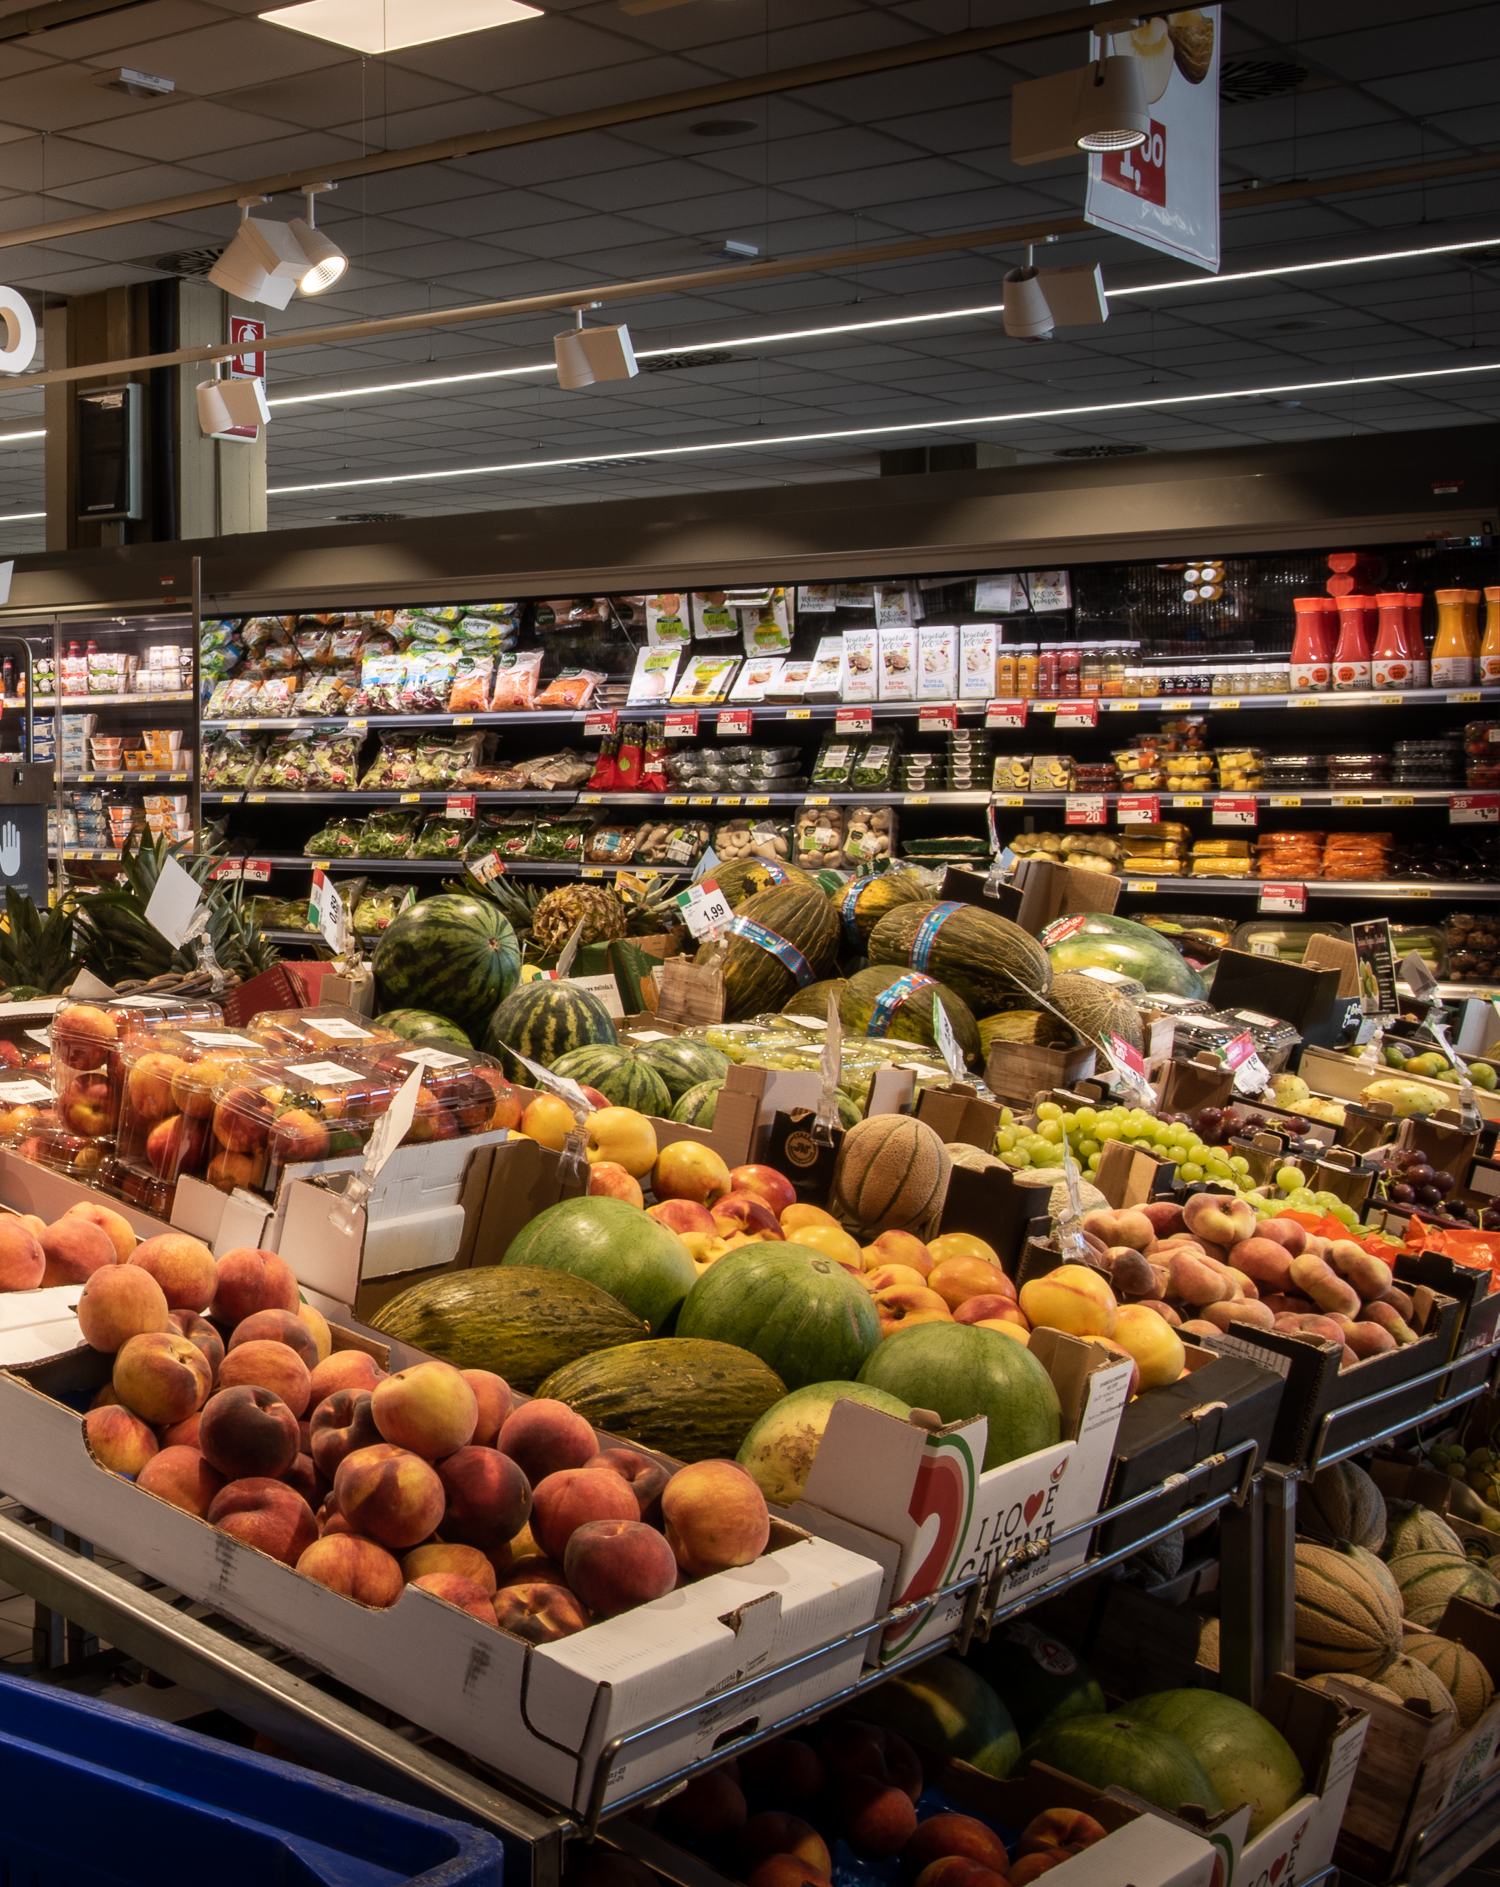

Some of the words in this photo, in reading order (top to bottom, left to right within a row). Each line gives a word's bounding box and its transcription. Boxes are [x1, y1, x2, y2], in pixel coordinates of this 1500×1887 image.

[1479, 808, 1497, 819] 1,99
[703, 903, 725, 922] 1,99
[1008, 1572, 1030, 1590] senza
[1031, 1559, 1051, 1579] semi
